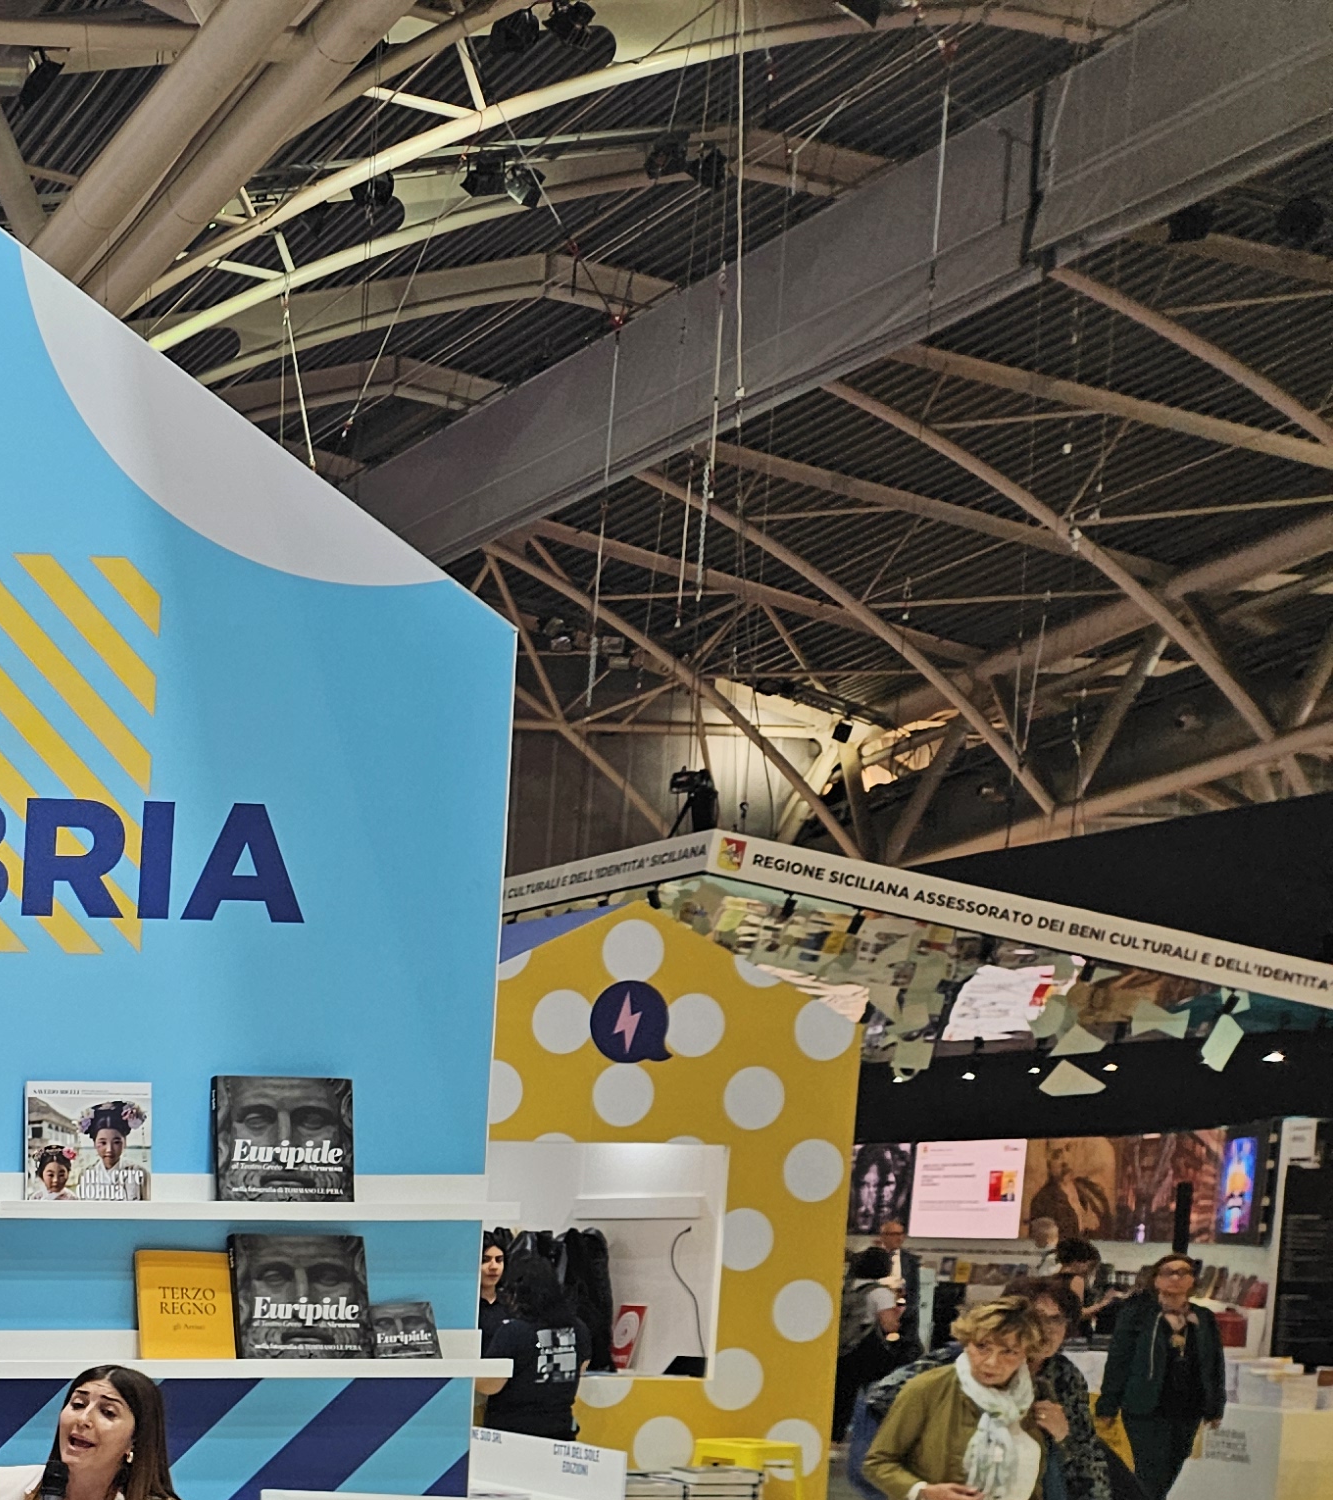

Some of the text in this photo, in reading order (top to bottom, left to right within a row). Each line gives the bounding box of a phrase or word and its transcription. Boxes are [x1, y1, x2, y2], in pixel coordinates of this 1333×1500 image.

[508, 876, 561, 900] CULTURALI
[651, 844, 707, 867] SICILIANA
[753, 854, 824, 881] REGIONE
[829, 871, 910, 901] SICILIANA
[913, 888, 1033, 926] ASSESSORATO
[1038, 915, 1064, 933] DEI
[1068, 922, 1105, 943] BENI
[1109, 932, 1198, 962] CULTURALI
[1201, 951, 1211, 965] E
[232, 1139, 343, 1169] Euripide
[158, 1286, 215, 1300] TERZO
[160, 1302, 216, 1316] REGNO
[253, 1297, 360, 1326] Euripide
[376, 1331, 432, 1345] Euripide
